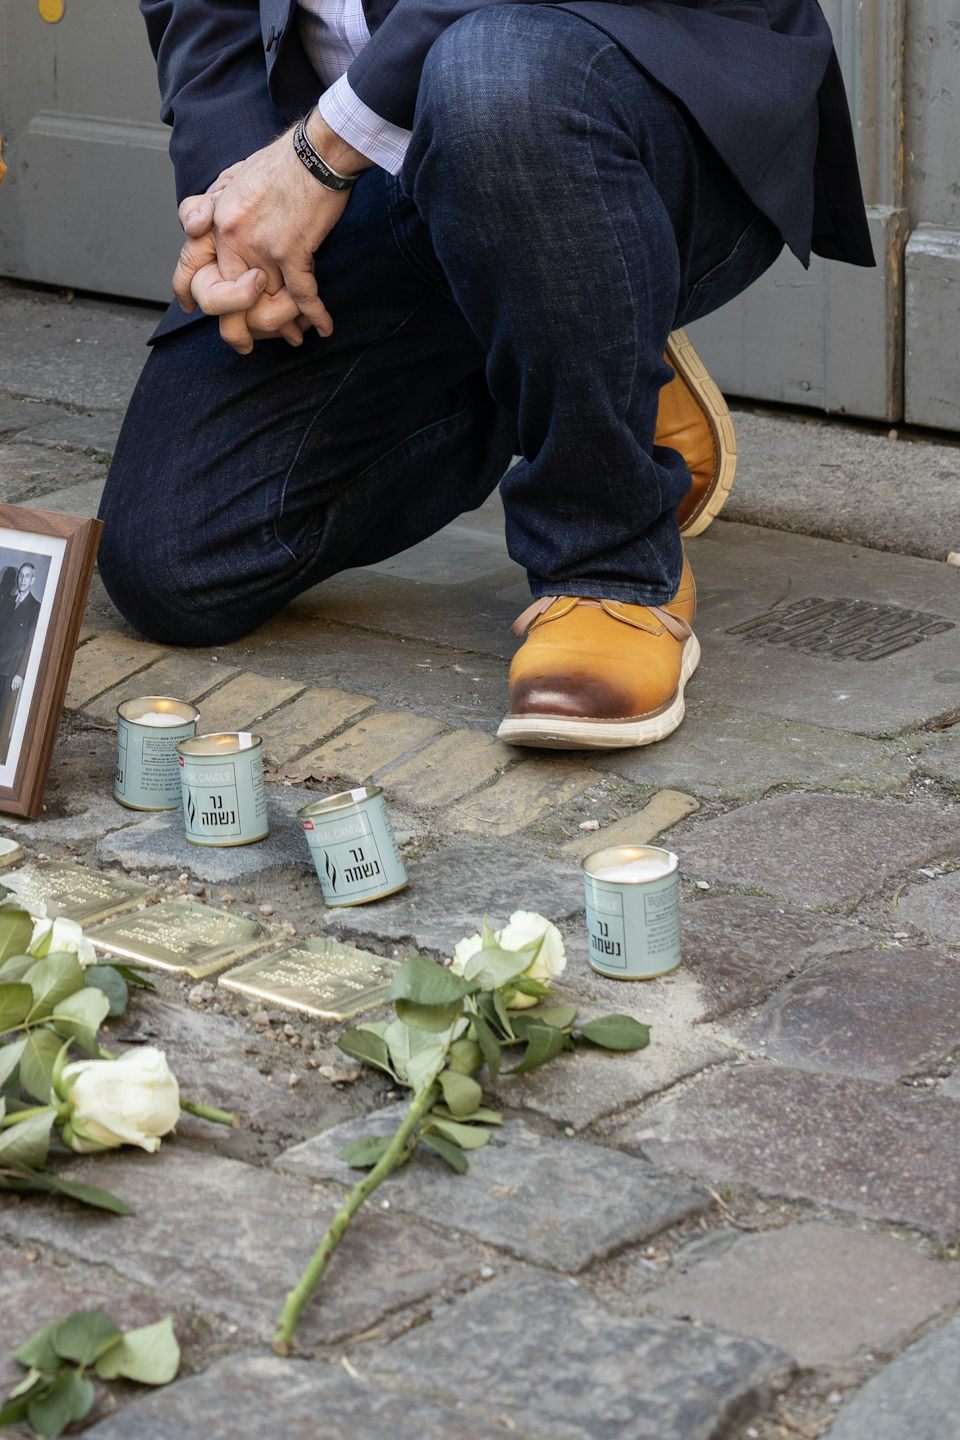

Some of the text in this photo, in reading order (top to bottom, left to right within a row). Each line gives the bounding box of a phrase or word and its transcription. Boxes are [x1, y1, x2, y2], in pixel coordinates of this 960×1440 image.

[209, 795, 222, 809] נר
[201, 810, 236, 826] נשמה
[349, 847, 365, 863] נר
[343, 860, 380, 883] נשמה
[597, 920, 609, 937] נר
[591, 934, 621, 957] נשמה
